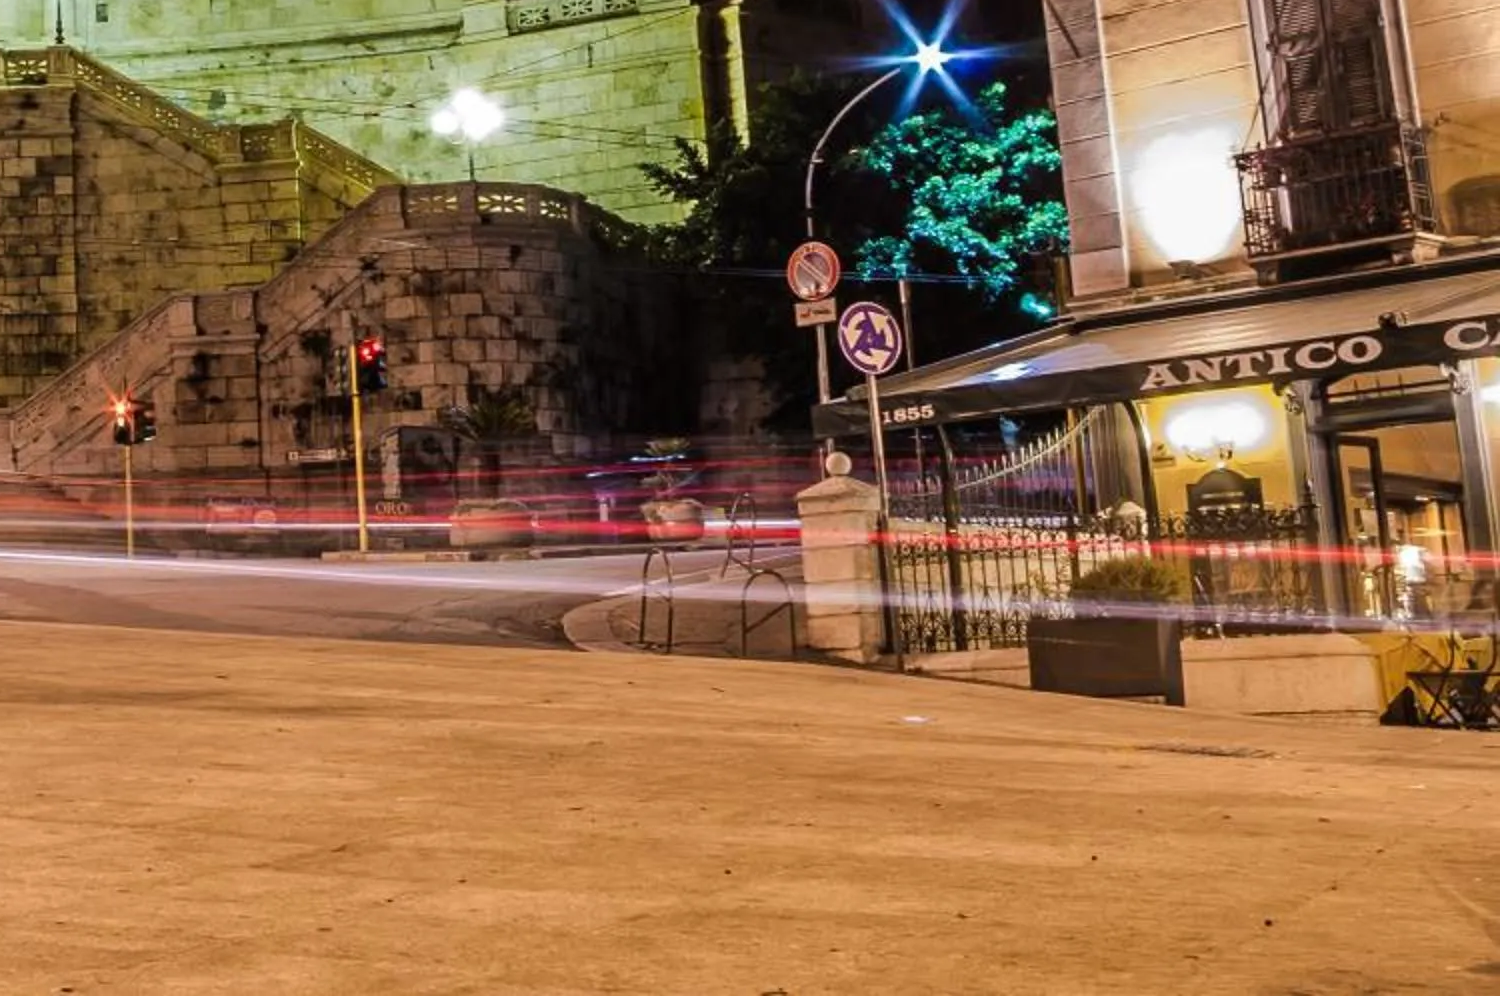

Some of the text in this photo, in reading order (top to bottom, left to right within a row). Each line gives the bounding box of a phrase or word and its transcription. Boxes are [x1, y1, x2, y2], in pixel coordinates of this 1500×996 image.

[1140, 319, 1500, 390] ANTICO C
[882, 404, 935, 424] 1855
